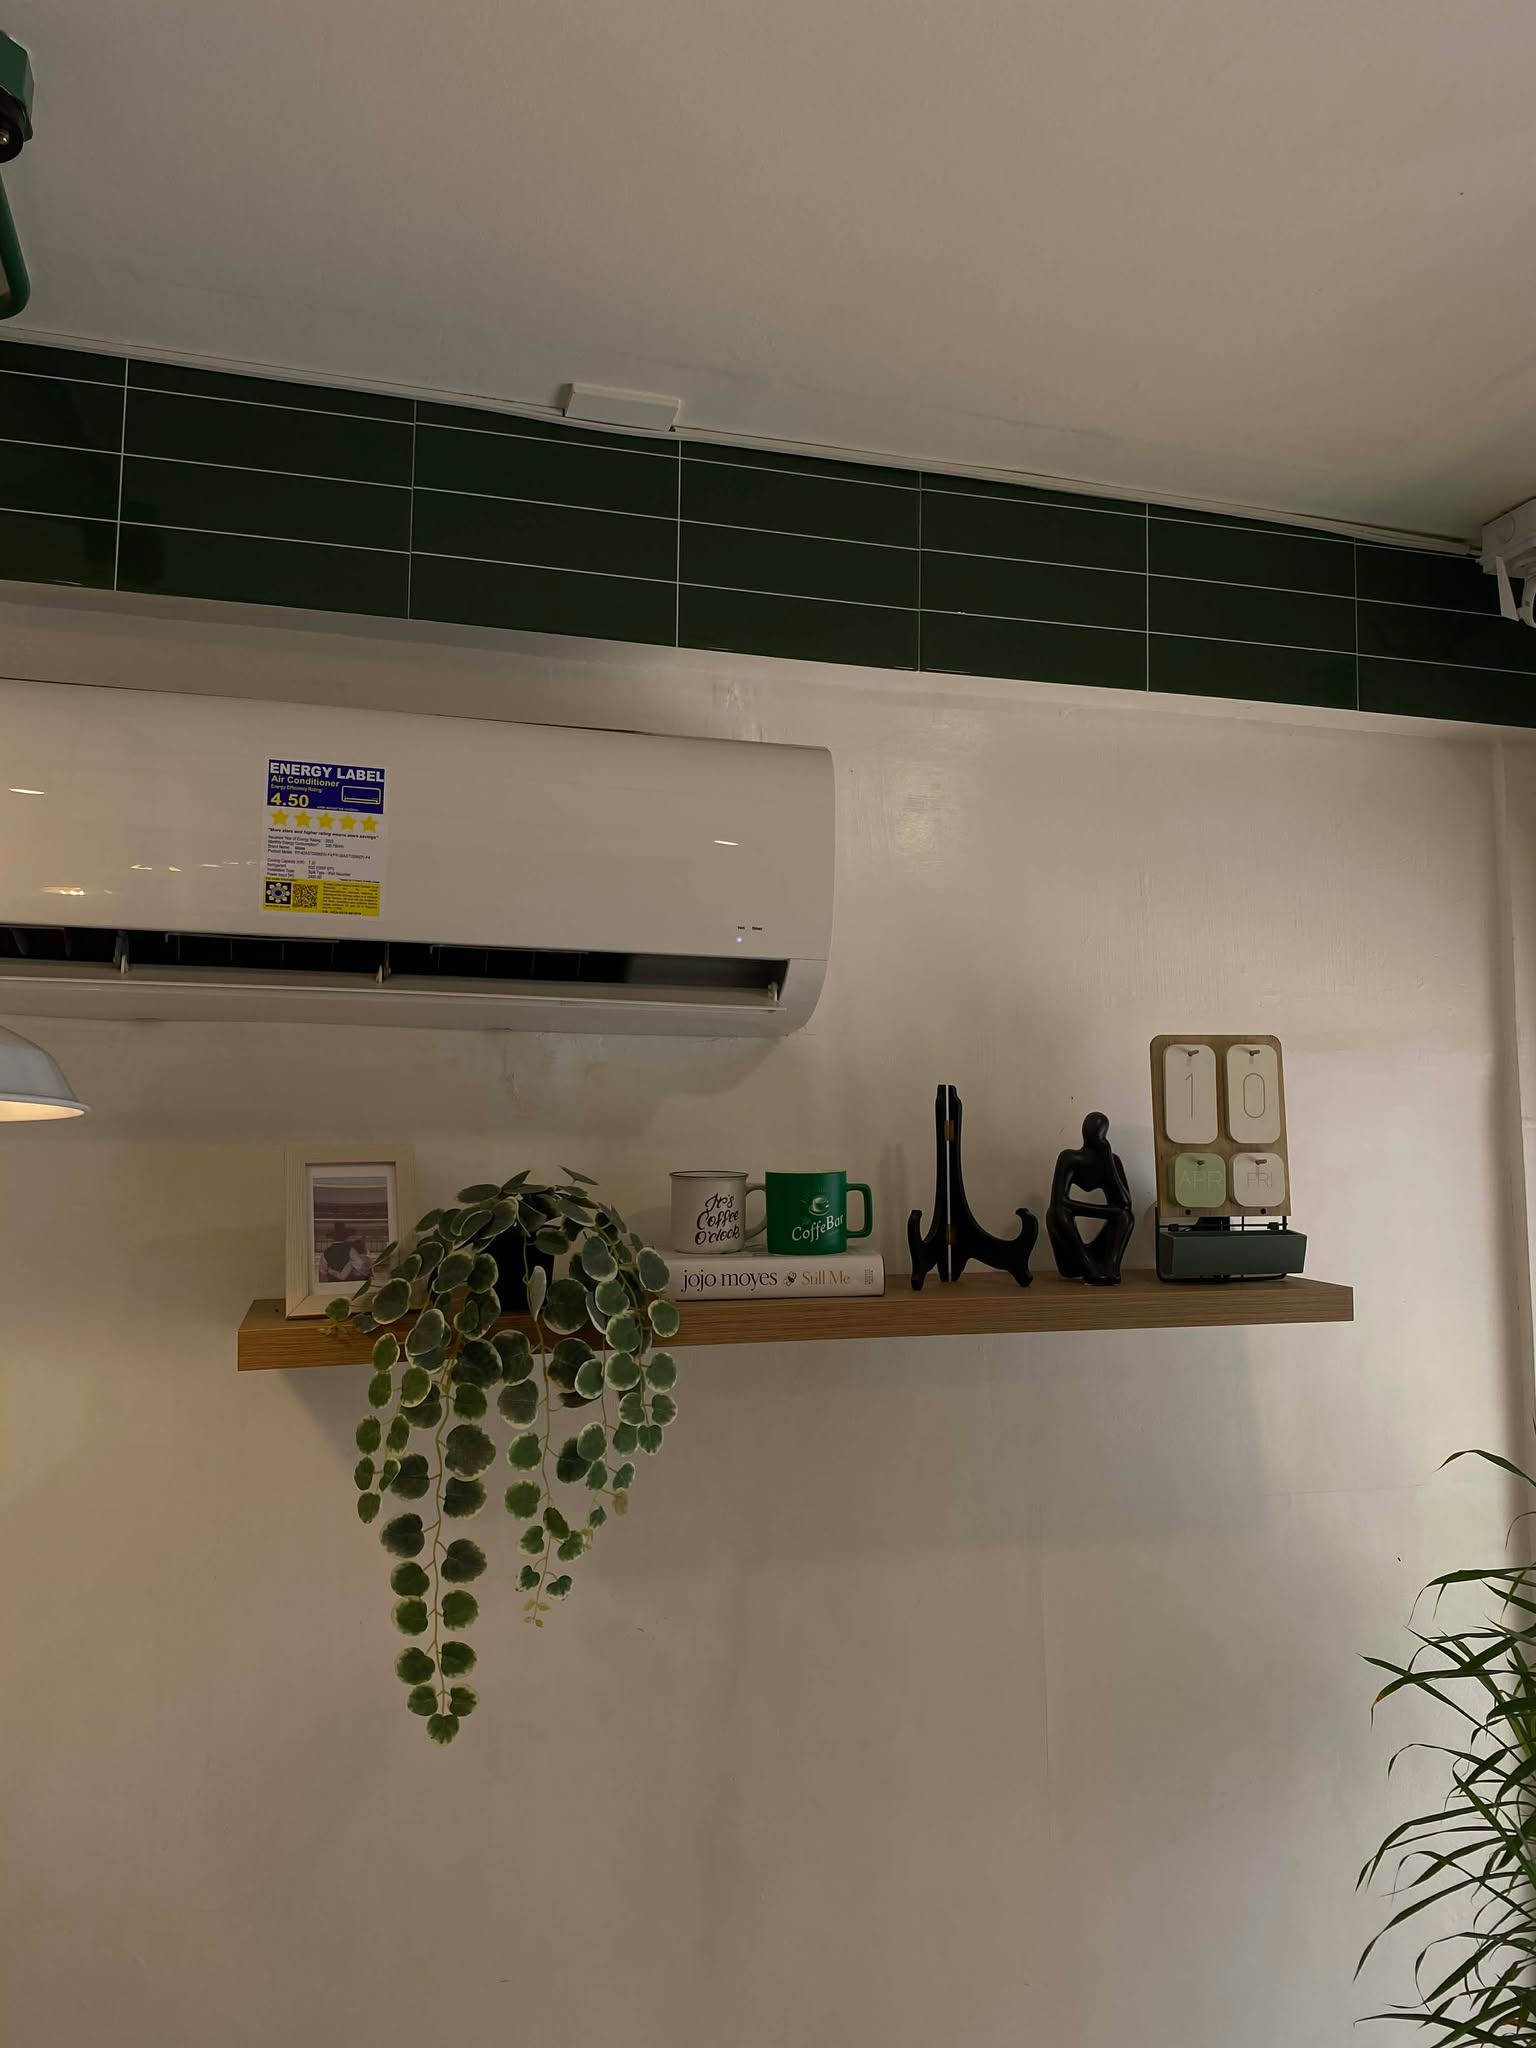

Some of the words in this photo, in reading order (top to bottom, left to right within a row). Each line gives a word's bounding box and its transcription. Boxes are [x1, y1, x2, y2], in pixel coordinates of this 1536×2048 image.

[270, 762, 332, 778] ENERGY
[336, 767, 385, 783] LABEL
[271, 775, 285, 783] Air
[287, 776, 340, 788] Conditioner
[270, 783, 286, 791] Energy
[270, 792, 309, 808] 4.50
[1185, 1072, 1194, 1121] 1
[1243, 1072, 1265, 1119] 0
[704, 1192, 735, 1212] It's
[696, 1208, 739, 1231] Coffee
[791, 1213, 844, 1243] CoffeBar
[694, 1224, 741, 1246] O'clock
[680, 1269, 717, 1294] jojo
[720, 1271, 778, 1292] moyes
[801, 1270, 826, 1286] Still
[828, 1270, 850, 1286] Me
